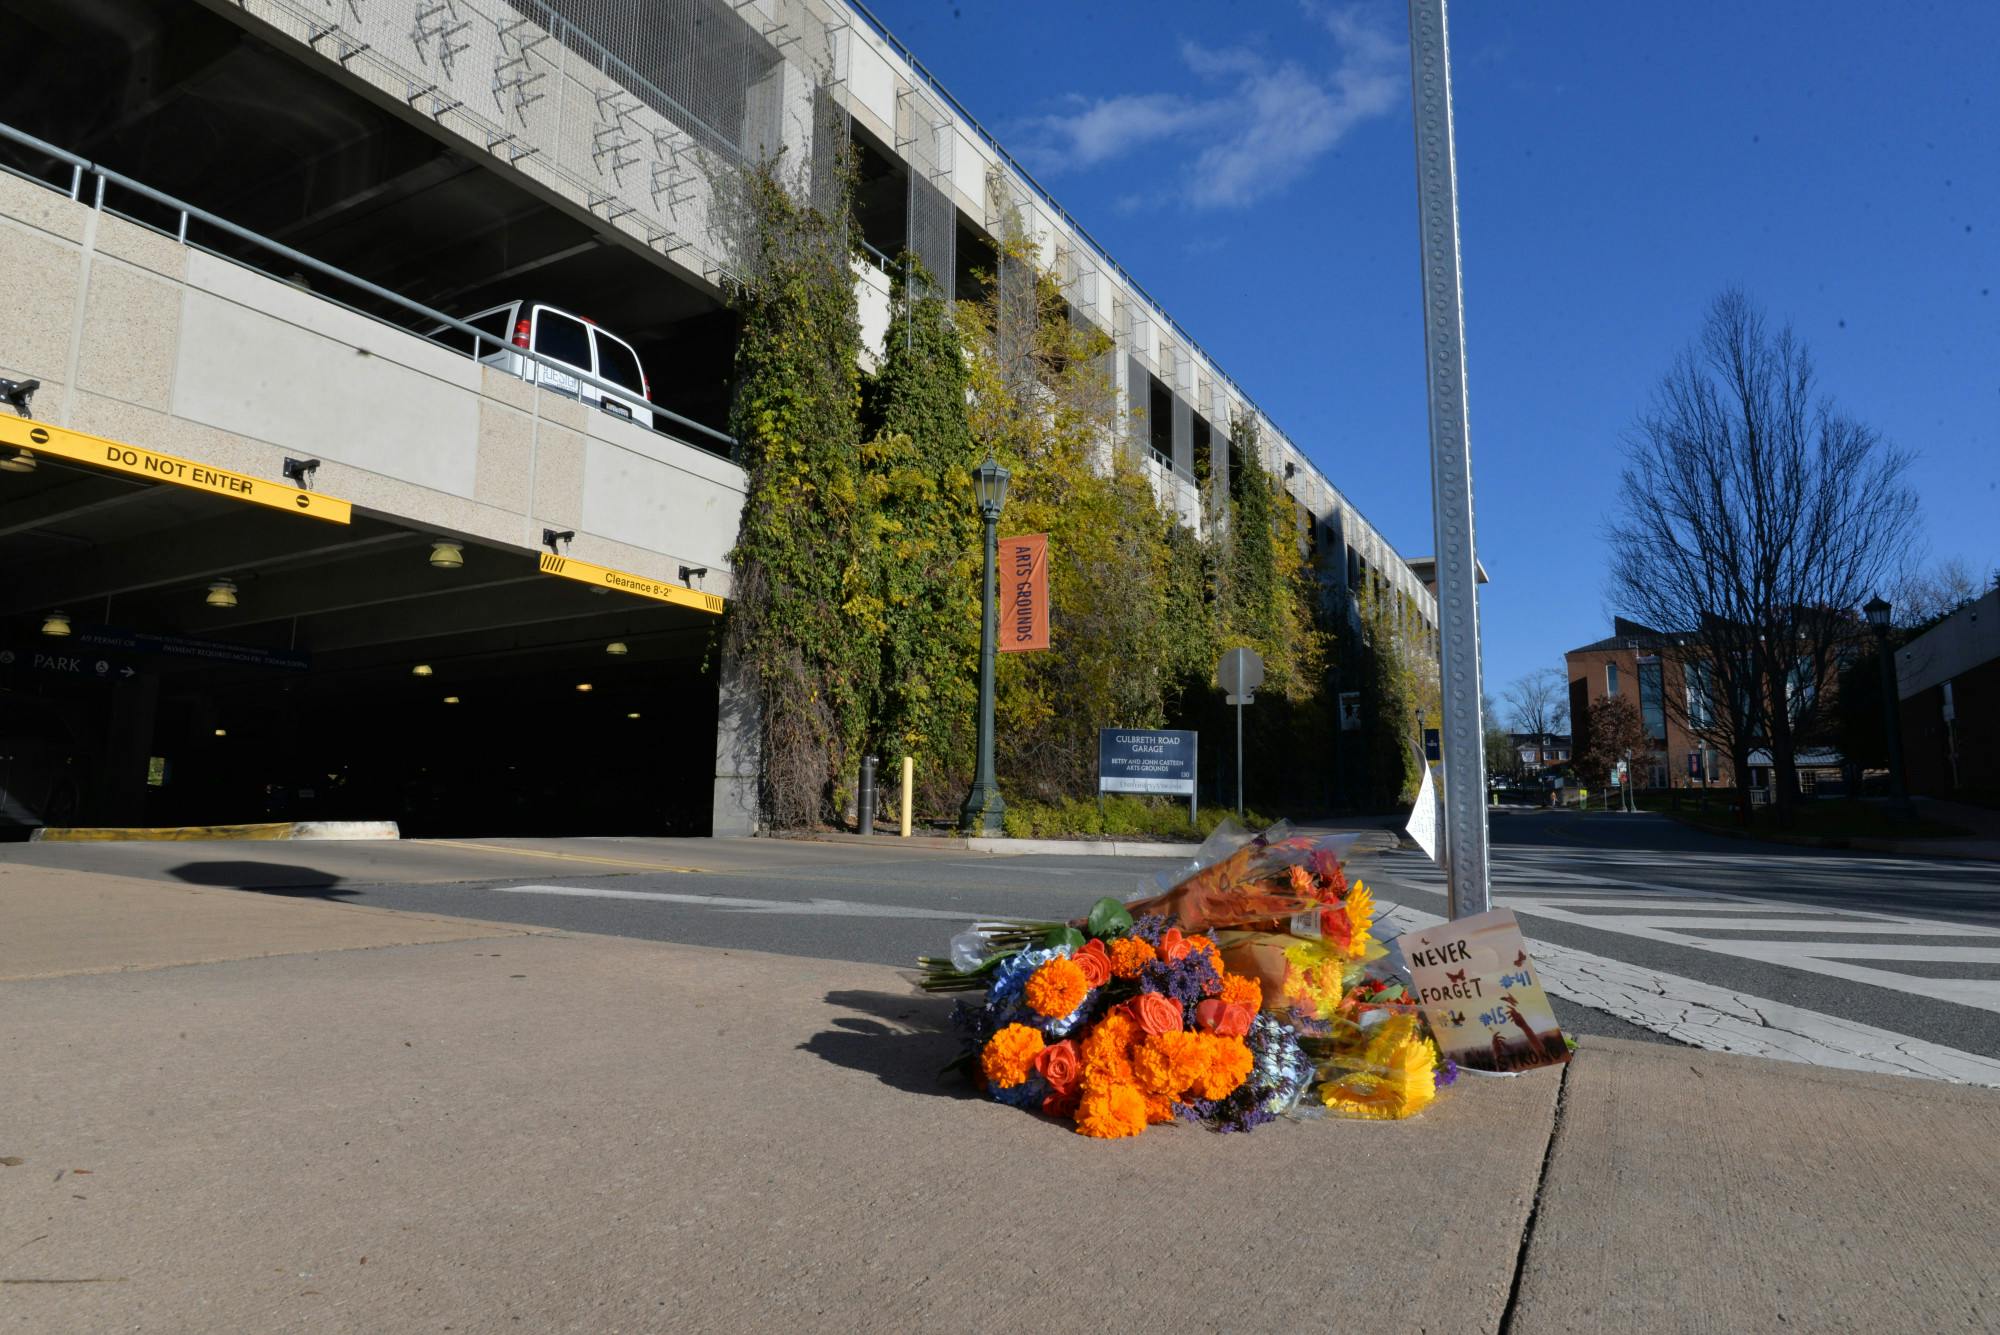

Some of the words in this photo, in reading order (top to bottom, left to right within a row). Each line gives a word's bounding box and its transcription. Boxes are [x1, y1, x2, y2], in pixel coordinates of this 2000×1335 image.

[106, 446, 138, 466] DO
[144, 455, 187, 478] NOT
[192, 467, 254, 496] ENTER
[1015, 546, 1032, 577] ARTS
[605, 572, 651, 593] Clearance
[1016, 582, 1032, 642] GROUNDS
[33, 653, 81, 673] PARK
[1115, 735, 1156, 744] CULBRETH
[1158, 736, 1180, 745] ROAD
[1131, 744, 1164, 753] GARAGE
[1140, 765, 1169, 773] GROUNDS
[1411, 939, 1472, 968] NEVER
[1420, 977, 1482, 1005] FORGET
[1479, 1005, 1507, 1027] #15
